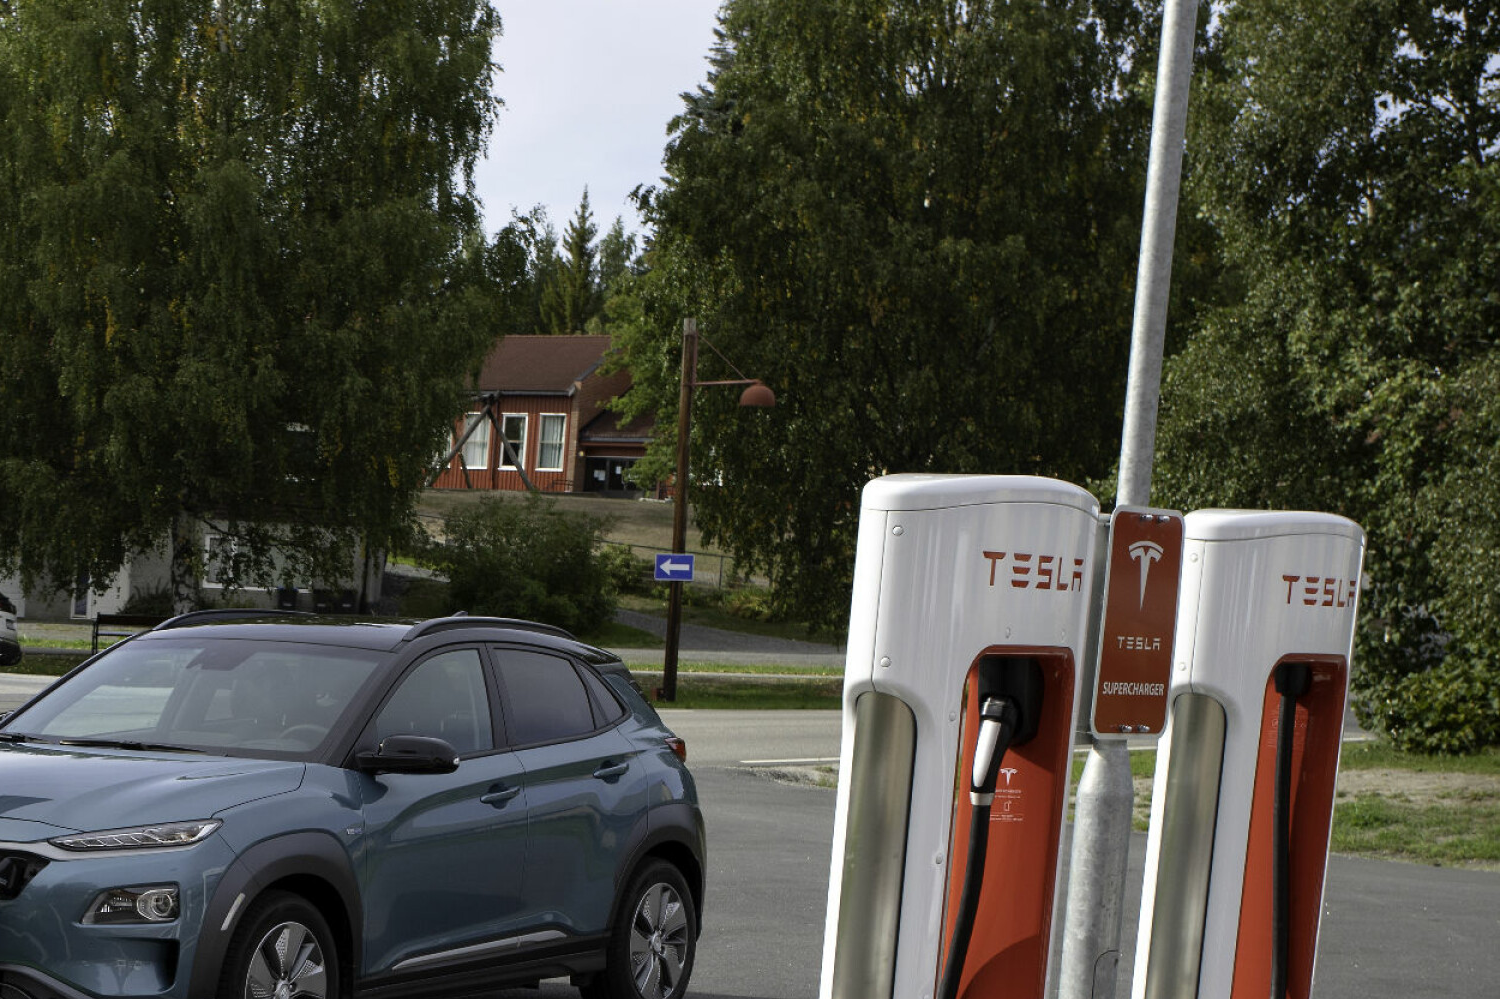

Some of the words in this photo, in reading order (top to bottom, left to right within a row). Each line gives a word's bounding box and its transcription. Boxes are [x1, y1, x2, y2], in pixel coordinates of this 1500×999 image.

[982, 551, 1084, 592] TESLA
[1282, 574, 1357, 608] TESLA
[1117, 636, 1161, 651] TESLA
[1102, 681, 1165, 696] SUPERCHARGER
